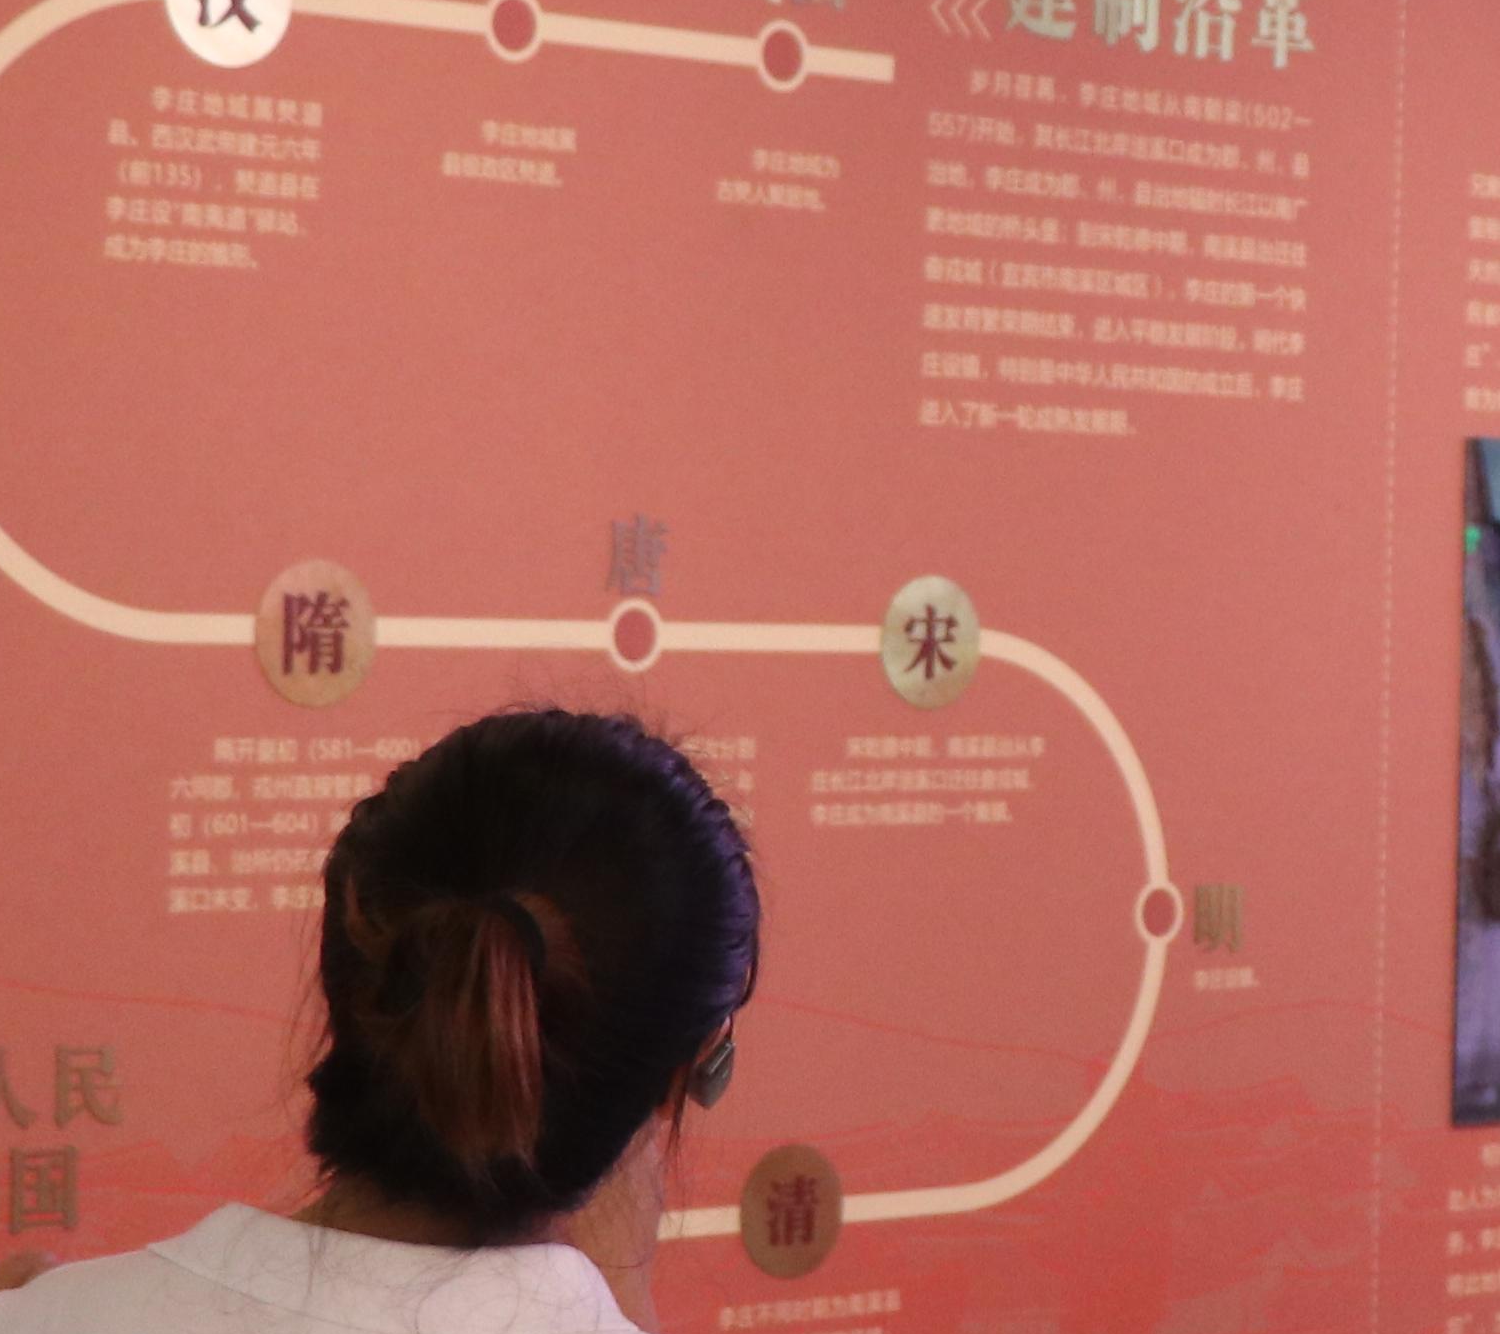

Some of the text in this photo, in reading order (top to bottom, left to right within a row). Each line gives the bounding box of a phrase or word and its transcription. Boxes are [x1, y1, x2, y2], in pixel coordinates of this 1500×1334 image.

[281, 589, 350, 677] 隋
[903, 605, 960, 680] 宋
[766, 1174, 820, 1247] 清
